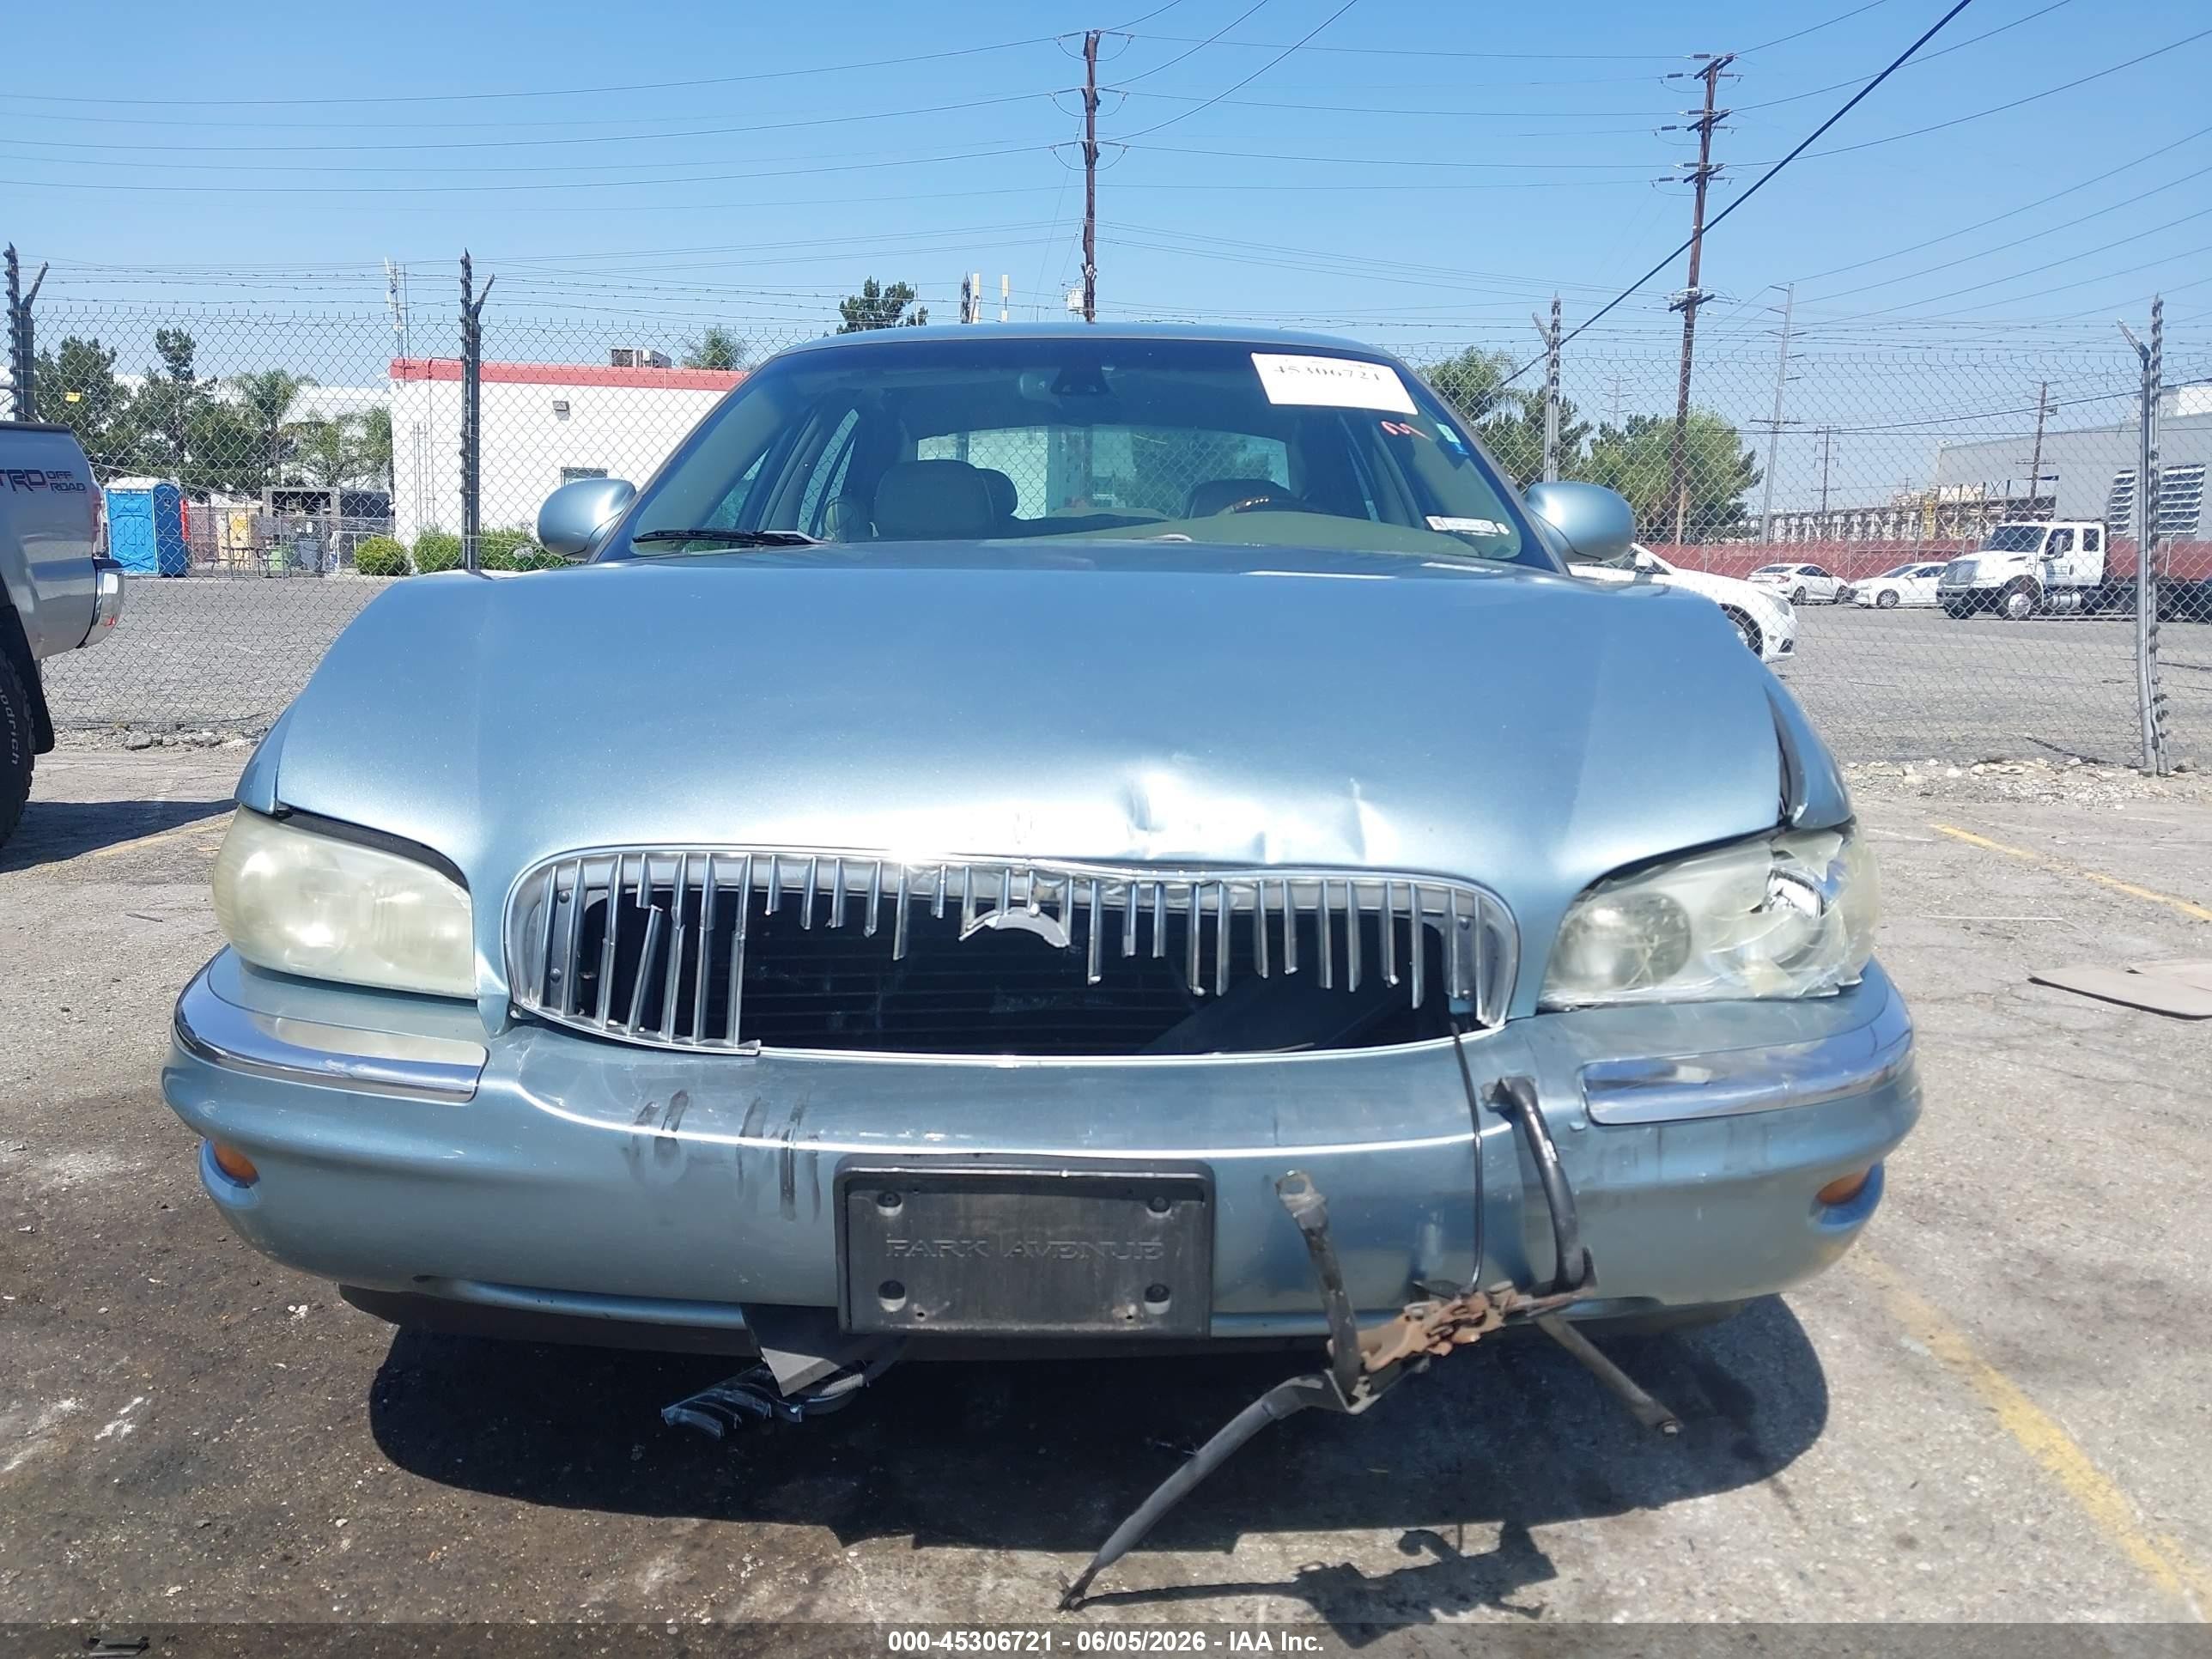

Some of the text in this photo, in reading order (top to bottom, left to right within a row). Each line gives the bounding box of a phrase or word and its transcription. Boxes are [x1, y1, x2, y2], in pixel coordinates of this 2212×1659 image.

[46, 471, 74, 480] OFF
[50, 482, 87, 493] ROAD
[885, 1238, 1164, 1260] PARK AVENUE
